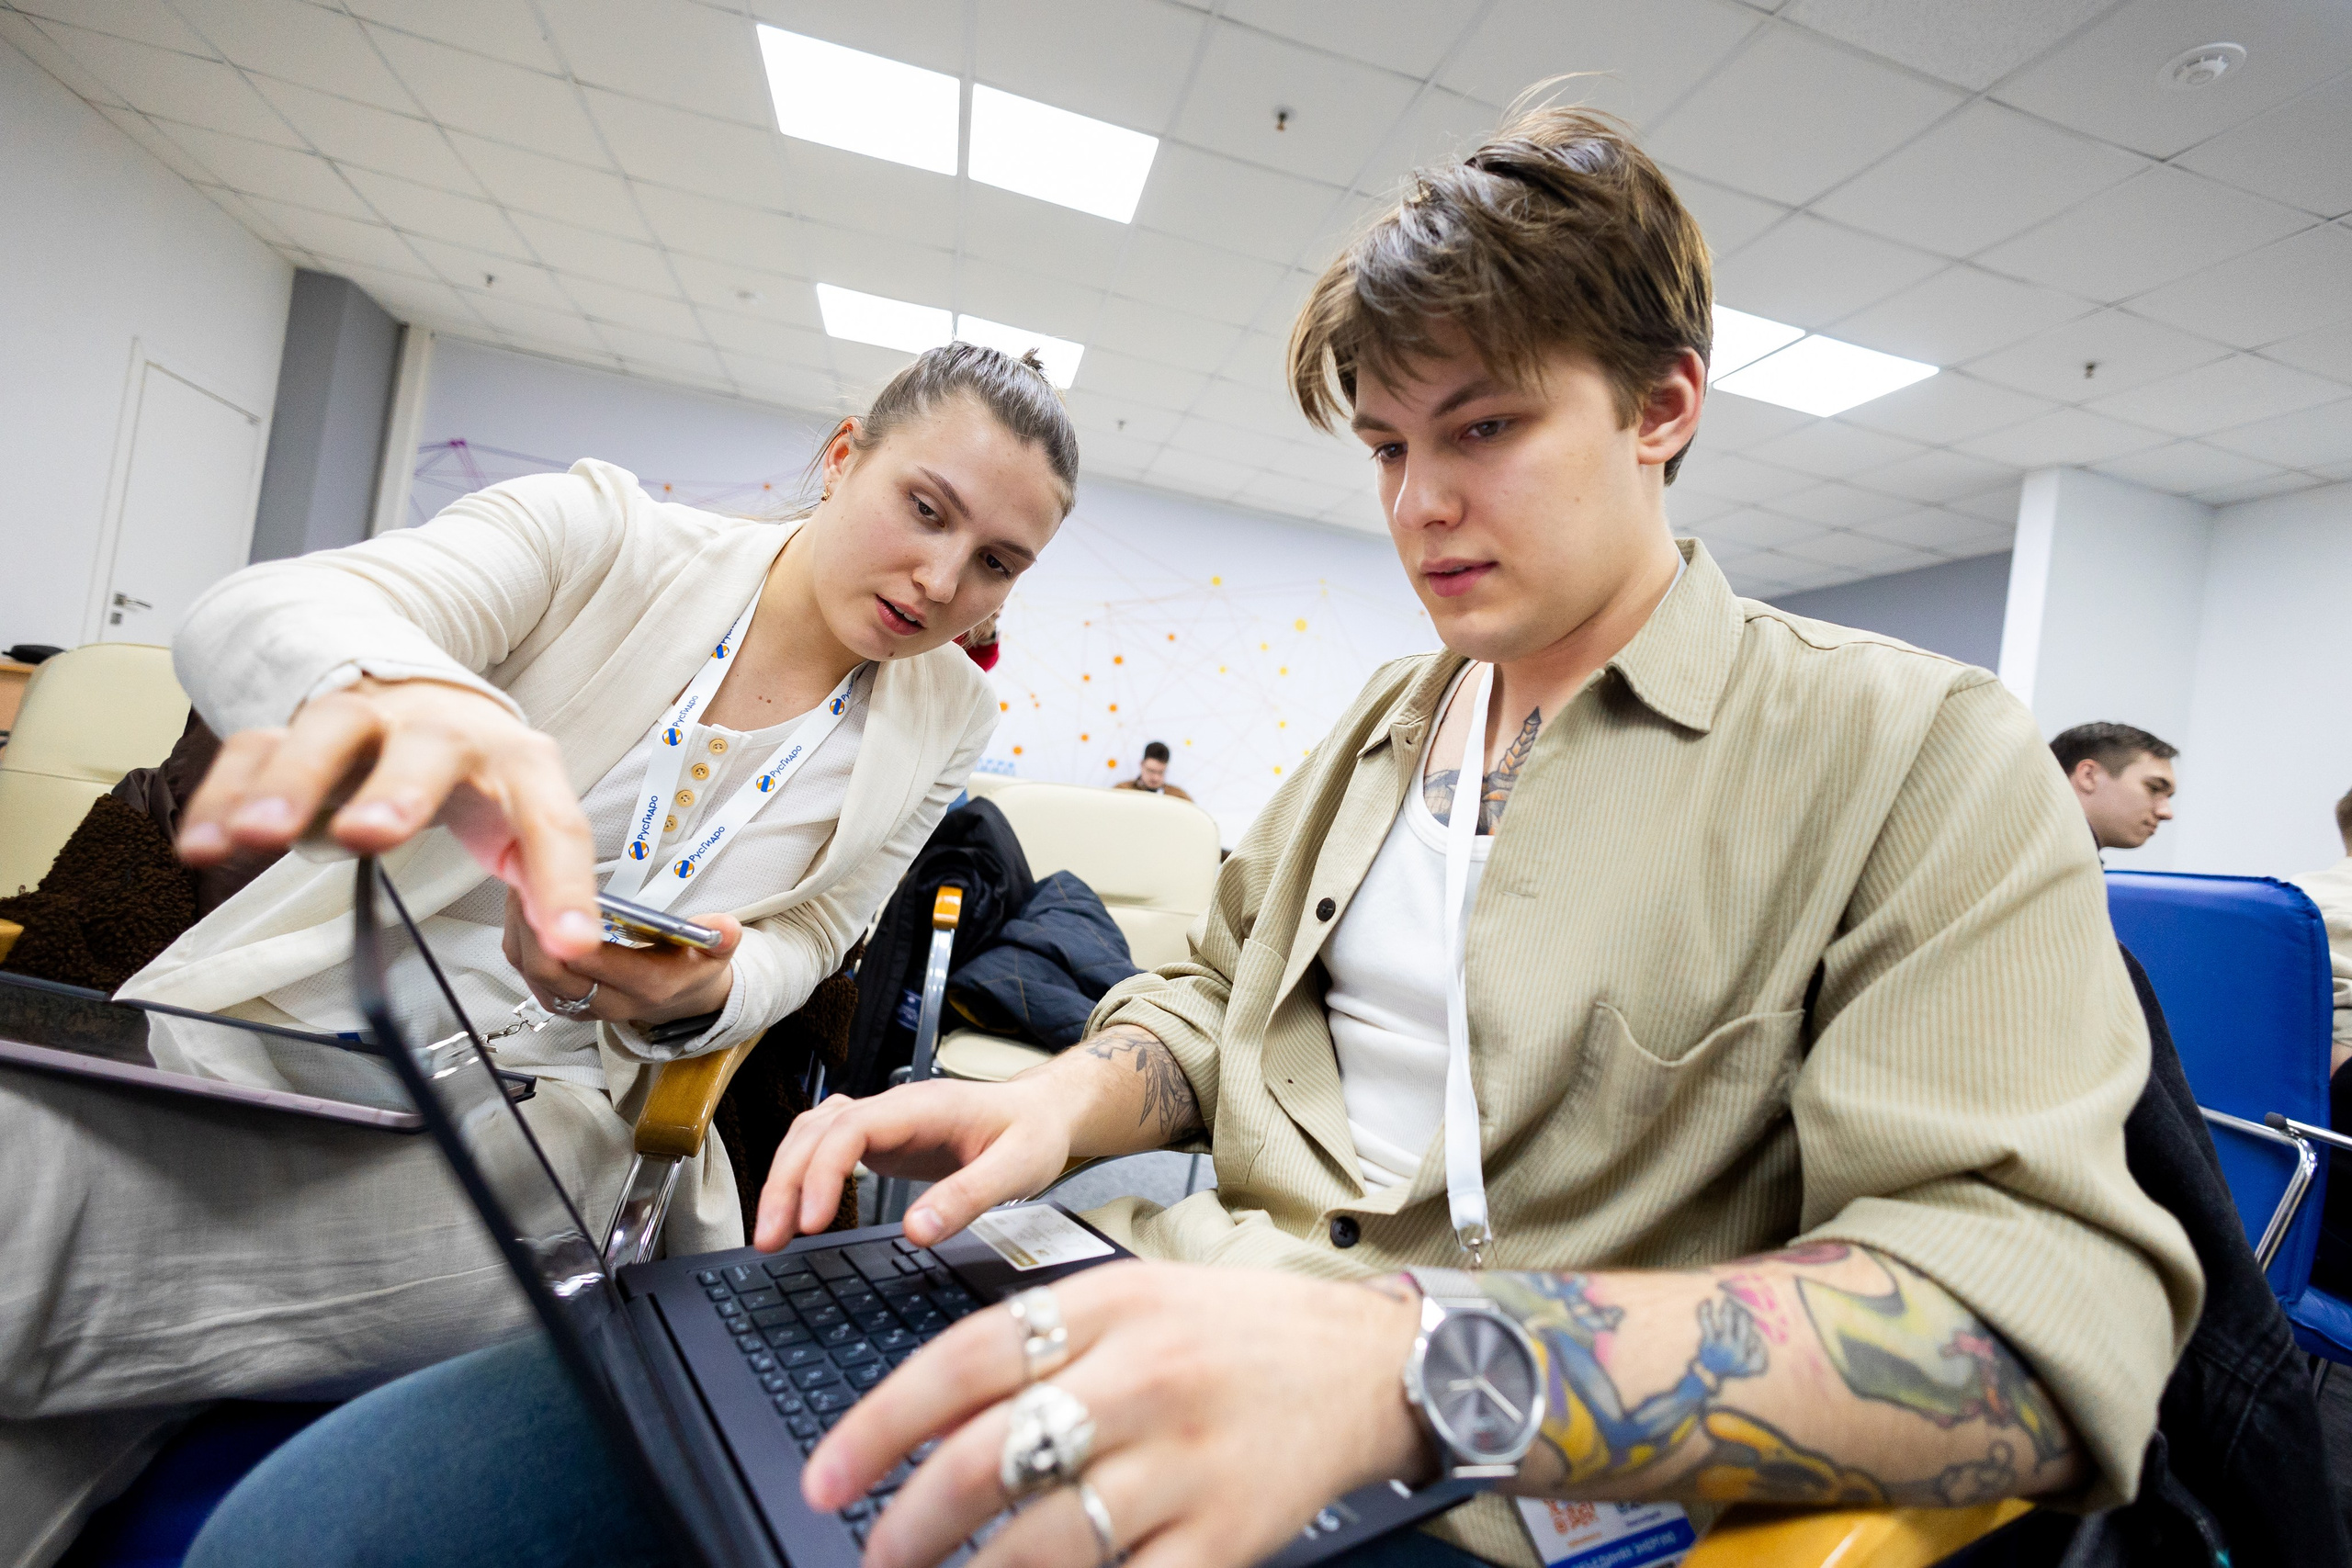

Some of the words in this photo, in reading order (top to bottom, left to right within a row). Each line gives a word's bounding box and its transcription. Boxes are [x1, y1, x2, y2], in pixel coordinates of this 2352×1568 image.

[673, 695, 698, 728] РусГидро
[770, 745, 802, 778] РусГидро
[637, 795, 659, 840] РусГидро
[688, 826, 726, 863] РусГидро
